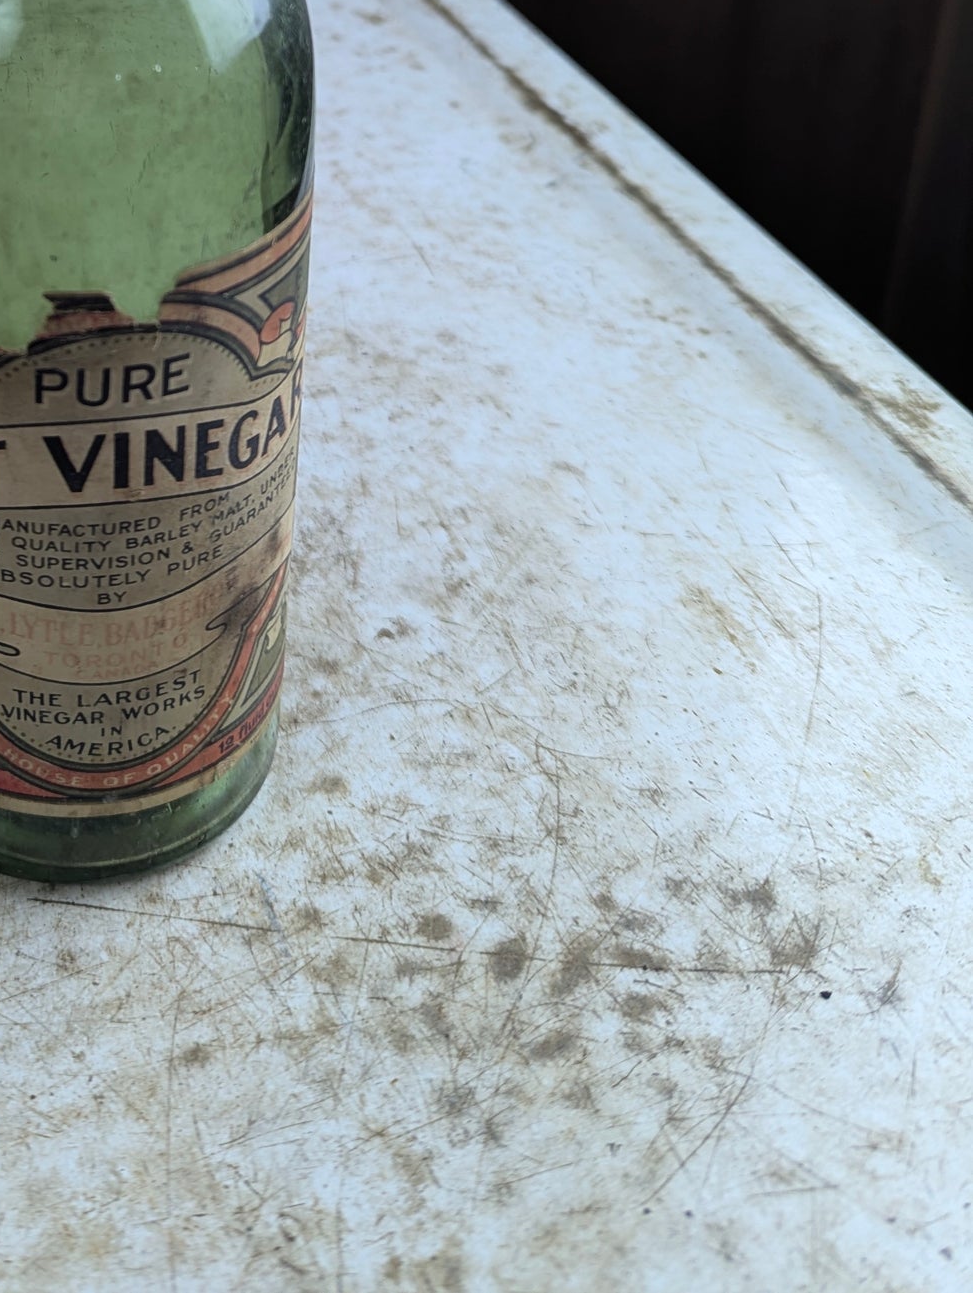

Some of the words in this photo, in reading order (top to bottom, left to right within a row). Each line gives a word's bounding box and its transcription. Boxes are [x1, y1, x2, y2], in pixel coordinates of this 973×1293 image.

[33, 352, 191, 406] PURE
[179, 490, 230, 521] FROM
[11, 536, 111, 553] QUALITY
[126, 520, 203, 550] BARLEY
[15, 547, 170, 570] SUPERVISION
[181, 541, 195, 555] &
[167, 544, 224, 577] PURE
[97, 590, 128, 605] BY
[12, 688, 63, 707] THE
[77, 669, 202, 707] LARGEST
[1, 704, 106, 725] VINEGAR
[122, 685, 206, 721] WORKS
[100, 724, 123, 737] IN
[2, 747, 84, 787] HOUSE
[102, 771, 138, 787] OF
